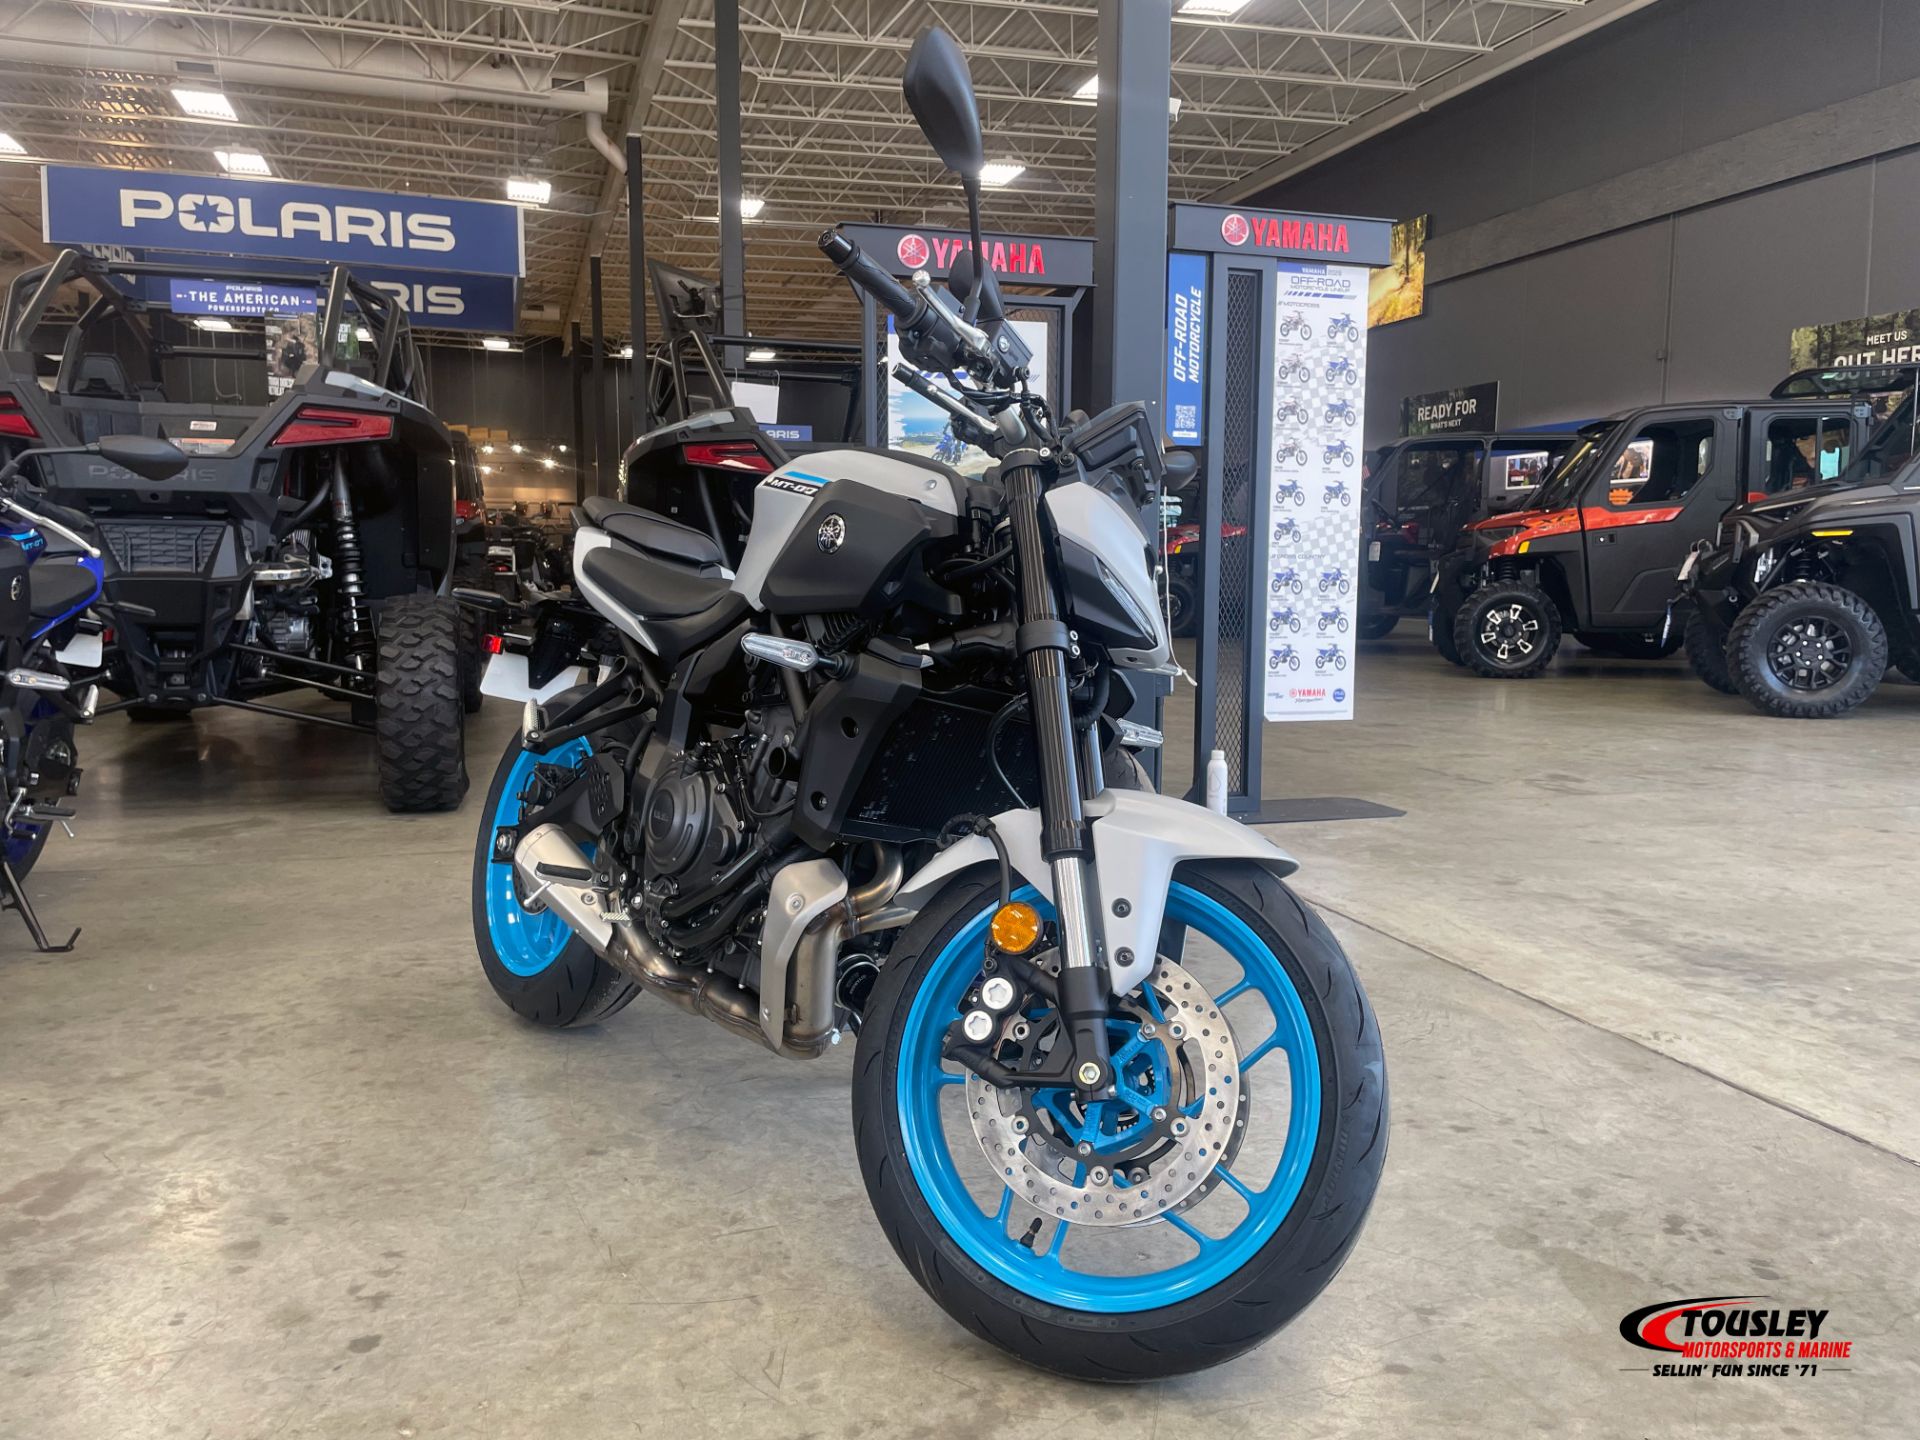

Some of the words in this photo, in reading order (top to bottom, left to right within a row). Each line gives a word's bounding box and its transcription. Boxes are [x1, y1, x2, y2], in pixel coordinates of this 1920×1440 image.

[119, 189, 456, 252] POLARIS
[1251, 217, 1349, 253] YAMAHA
[1291, 276, 1352, 288] OFF-ROAD
[189, 291, 217, 303] THE
[224, 293, 300, 306] AMERICAN
[1174, 293, 1188, 382] OFF-ROAD
[1188, 286, 1202, 383] MOTORCYCLE
[1866, 332, 1892, 346] MEET
[1894, 330, 1908, 341] US
[1417, 403, 1453, 422] READY
[1455, 398, 1477, 416] FOR
[1298, 688, 1326, 697] YAMAHA
